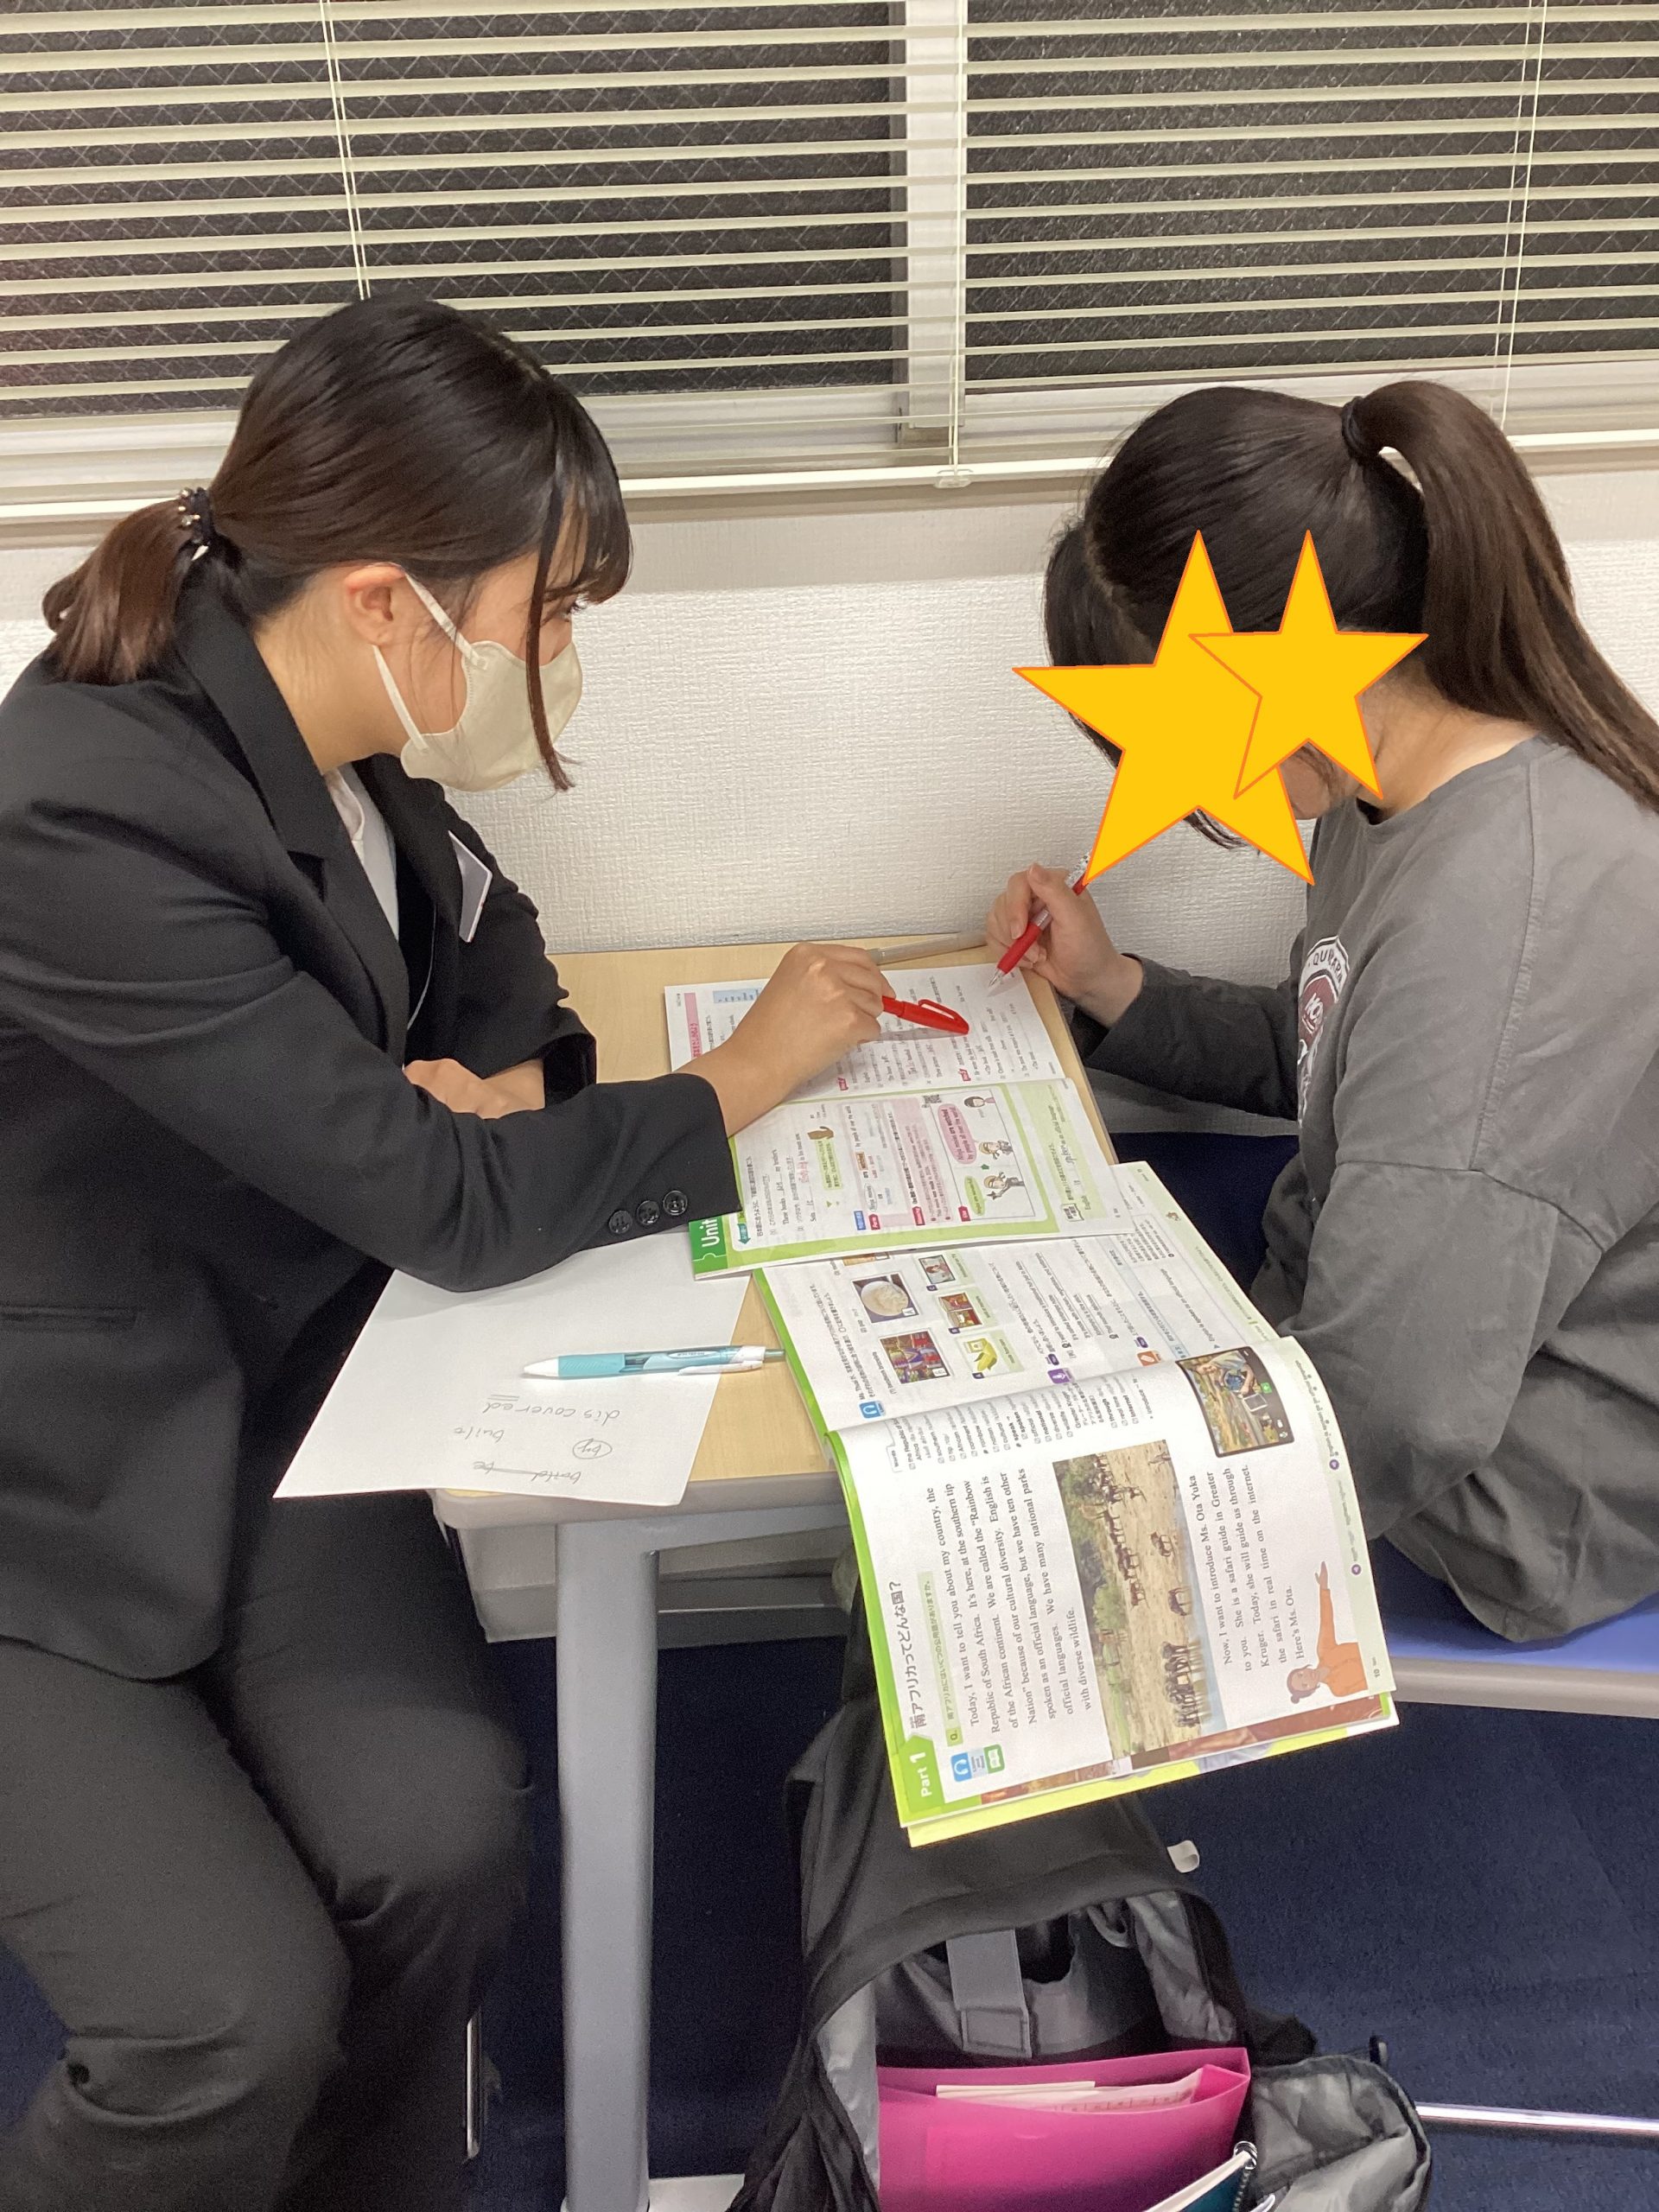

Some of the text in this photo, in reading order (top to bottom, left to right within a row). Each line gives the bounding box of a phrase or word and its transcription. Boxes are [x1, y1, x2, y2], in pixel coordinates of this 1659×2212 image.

[940, 1108, 953, 1127] watched
[950, 1134, 961, 1148] movies
[961, 1139, 972, 1154] people
[1079, 1194, 1091, 1211] English
[698, 1217, 721, 1248] Unit
[481, 1397, 620, 1425] discovered
[1101, 1397, 1115, 1422] through
[1116, 1407, 1125, 1420] real
[1007, 1421, 1019, 1441] speak
[1013, 1410, 1027, 1433] spoken
[1034, 1409, 1050, 1435] national
[898, 1428, 911, 1452] Republic
[912, 1442, 923, 1460] Africa
[953, 1430, 964, 1452] African
[944, 1483, 956, 1497] tip
[980, 1475, 990, 1485] is
[1188, 1474, 1201, 1502] Yuka
[1205, 1471, 1221, 1509] Greater
[925, 1487, 937, 1503] the
[982, 1485, 1000, 1523] English
[948, 1497, 964, 1538] southern
[1195, 1502, 1205, 1522] Ota
[1214, 1510, 1224, 1522] in
[931, 1504, 947, 1547] country,
[973, 1527, 984, 1543] the
[1198, 1522, 1211, 1543] Ms.
[957, 1539, 968, 1555] the
[1217, 1524, 1233, 1553] guide
[940, 1549, 951, 1567] my
[960, 1555, 970, 1567] at
[975, 1543, 991, 1573] called
[994, 1527, 1010, 1573] diversity.
[1204, 1544, 1220, 1591] introduce
[1222, 1467, 1270, 1668] Kruger. Today, she will guide us through
[1222, 1555, 1236, 1584] safari
[1240, 1464, 1287, 1664] the safari in real time on the internet.
[943, 1567, 957, 1597] about
[963, 1567, 976, 1592] here,
[983, 1573, 995, 1591] are
[985, 1591, 997, 1610] We
[999, 1471, 1058, 1719] spoken as an official language, but we have ten other
[1001, 1573, 1018, 1612] cultural
[1017, 1467, 1074, 1715] official languages. We have many national parks
[1213, 1592, 1222, 1604] to
[1230, 1596, 1241, 1606] is
[1284, 1585, 1295, 1607] Ota.
[950, 1599, 963, 1620] you
[1215, 1605, 1226, 1630] want
[1233, 1609, 1244, 1629] She
[1287, 1608, 1299, 1627] Ms.
[951, 1621, 964, 1640] tell
[972, 1612, 986, 1647] Africa.
[1010, 1612, 1021, 1631] our
[958, 1641, 967, 1654] to
[991, 1613, 1007, 1661] continent.
[1011, 1631, 1023, 1643] of
[1240, 1636, 1252, 1658] you.
[887, 1580, 927, 1728] 南アフリカってどんな国？
[976, 1648, 991, 1677] South
[1065, 1609, 1092, 1711] with diverse wildlife.
[1222, 1637, 1233, 1666] Now,
[959, 1655, 971, 1681] want
[1016, 1644, 1031, 1685] because
[1243, 1660, 1253, 1672] to
[1372, 1668, 1381, 1678] 10
[981, 1677, 993, 1689] of
[1000, 1661, 1014, 1698] African
[967, 1691, 980, 1727] Today,
[985, 1690, 1001, 1734] Republic
[1006, 1700, 1017, 1717] the
[1007, 1717, 1020, 1729] of
[949, 1728, 958, 1741] Q.
[908, 1751, 932, 1797] Part 1
